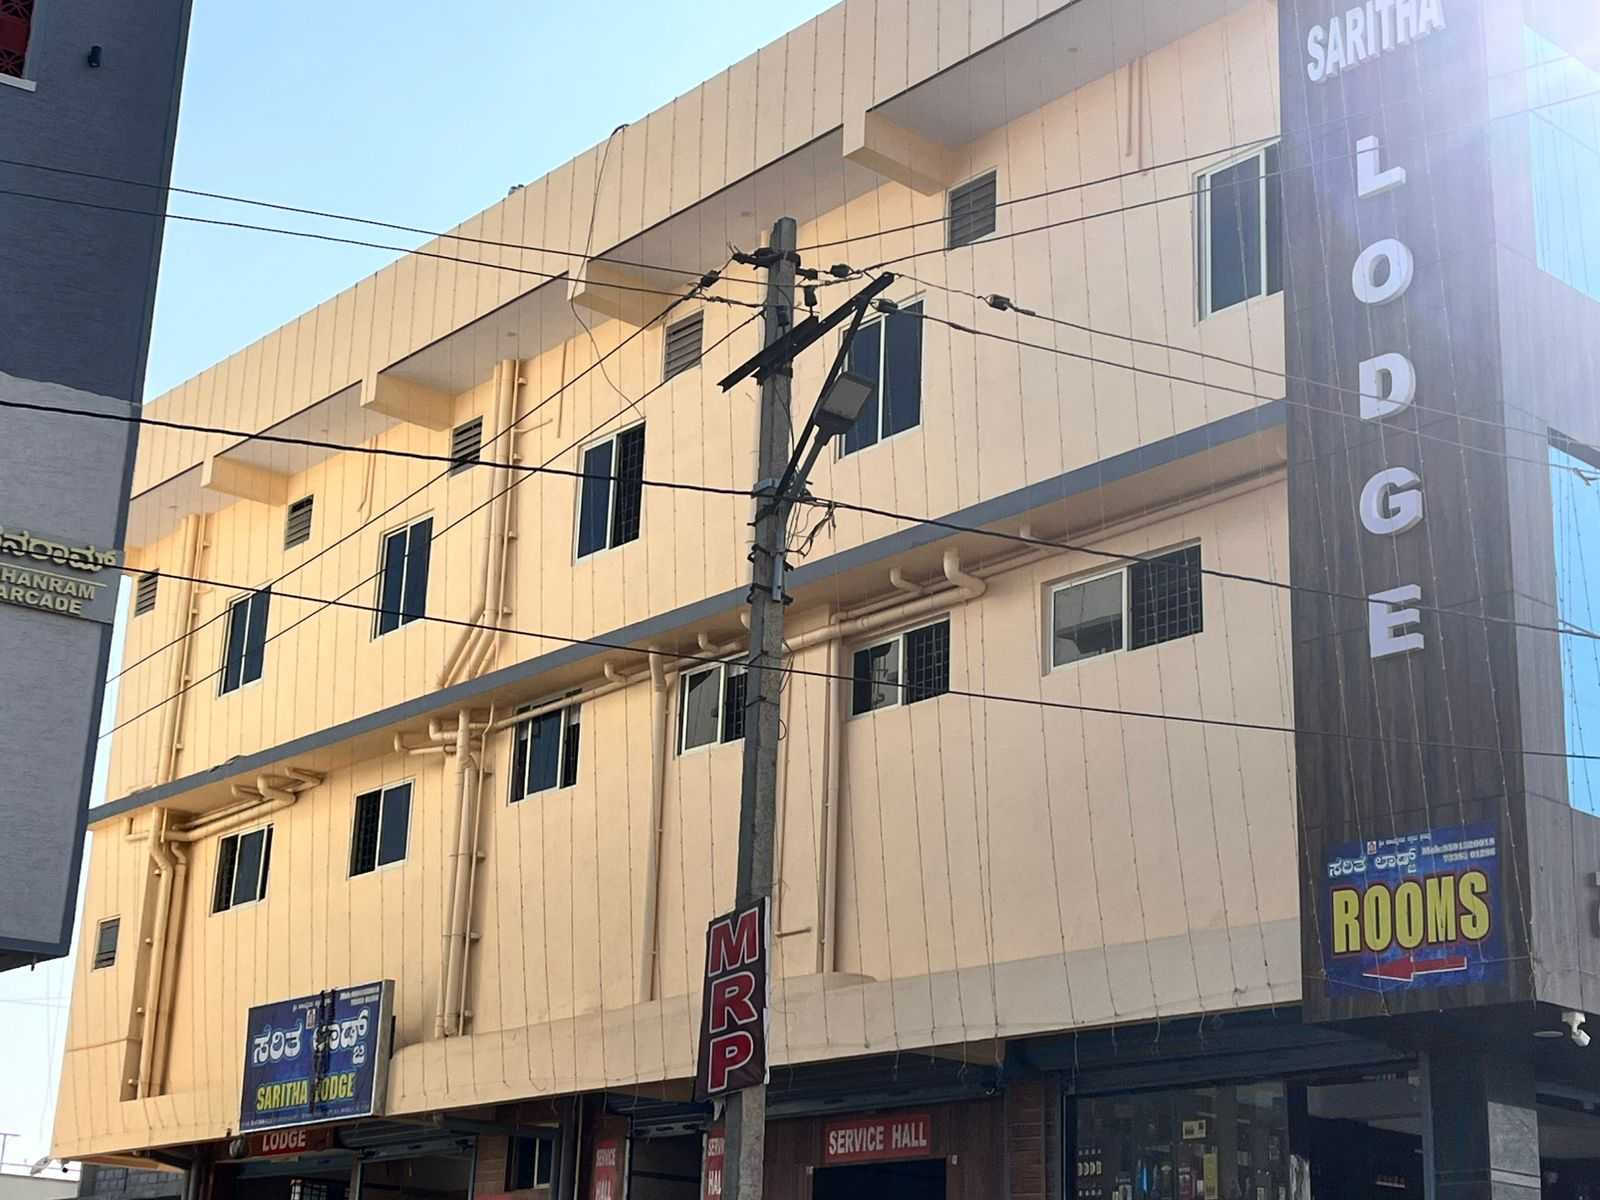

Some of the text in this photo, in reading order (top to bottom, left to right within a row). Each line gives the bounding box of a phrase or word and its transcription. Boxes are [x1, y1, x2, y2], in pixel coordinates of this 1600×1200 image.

[1307, 0, 1447, 82] SARITHA
[1352, 134, 1425, 658] LODGE
[0, 586, 82, 615] ARCADE
[1332, 870, 1490, 954] ROOMS
[708, 907, 759, 1092] MRP
[256, 1079, 309, 1111] SARITHA
[262, 1129, 307, 1152] LODGE
[829, 1121, 928, 1155] SERVICE HALL
